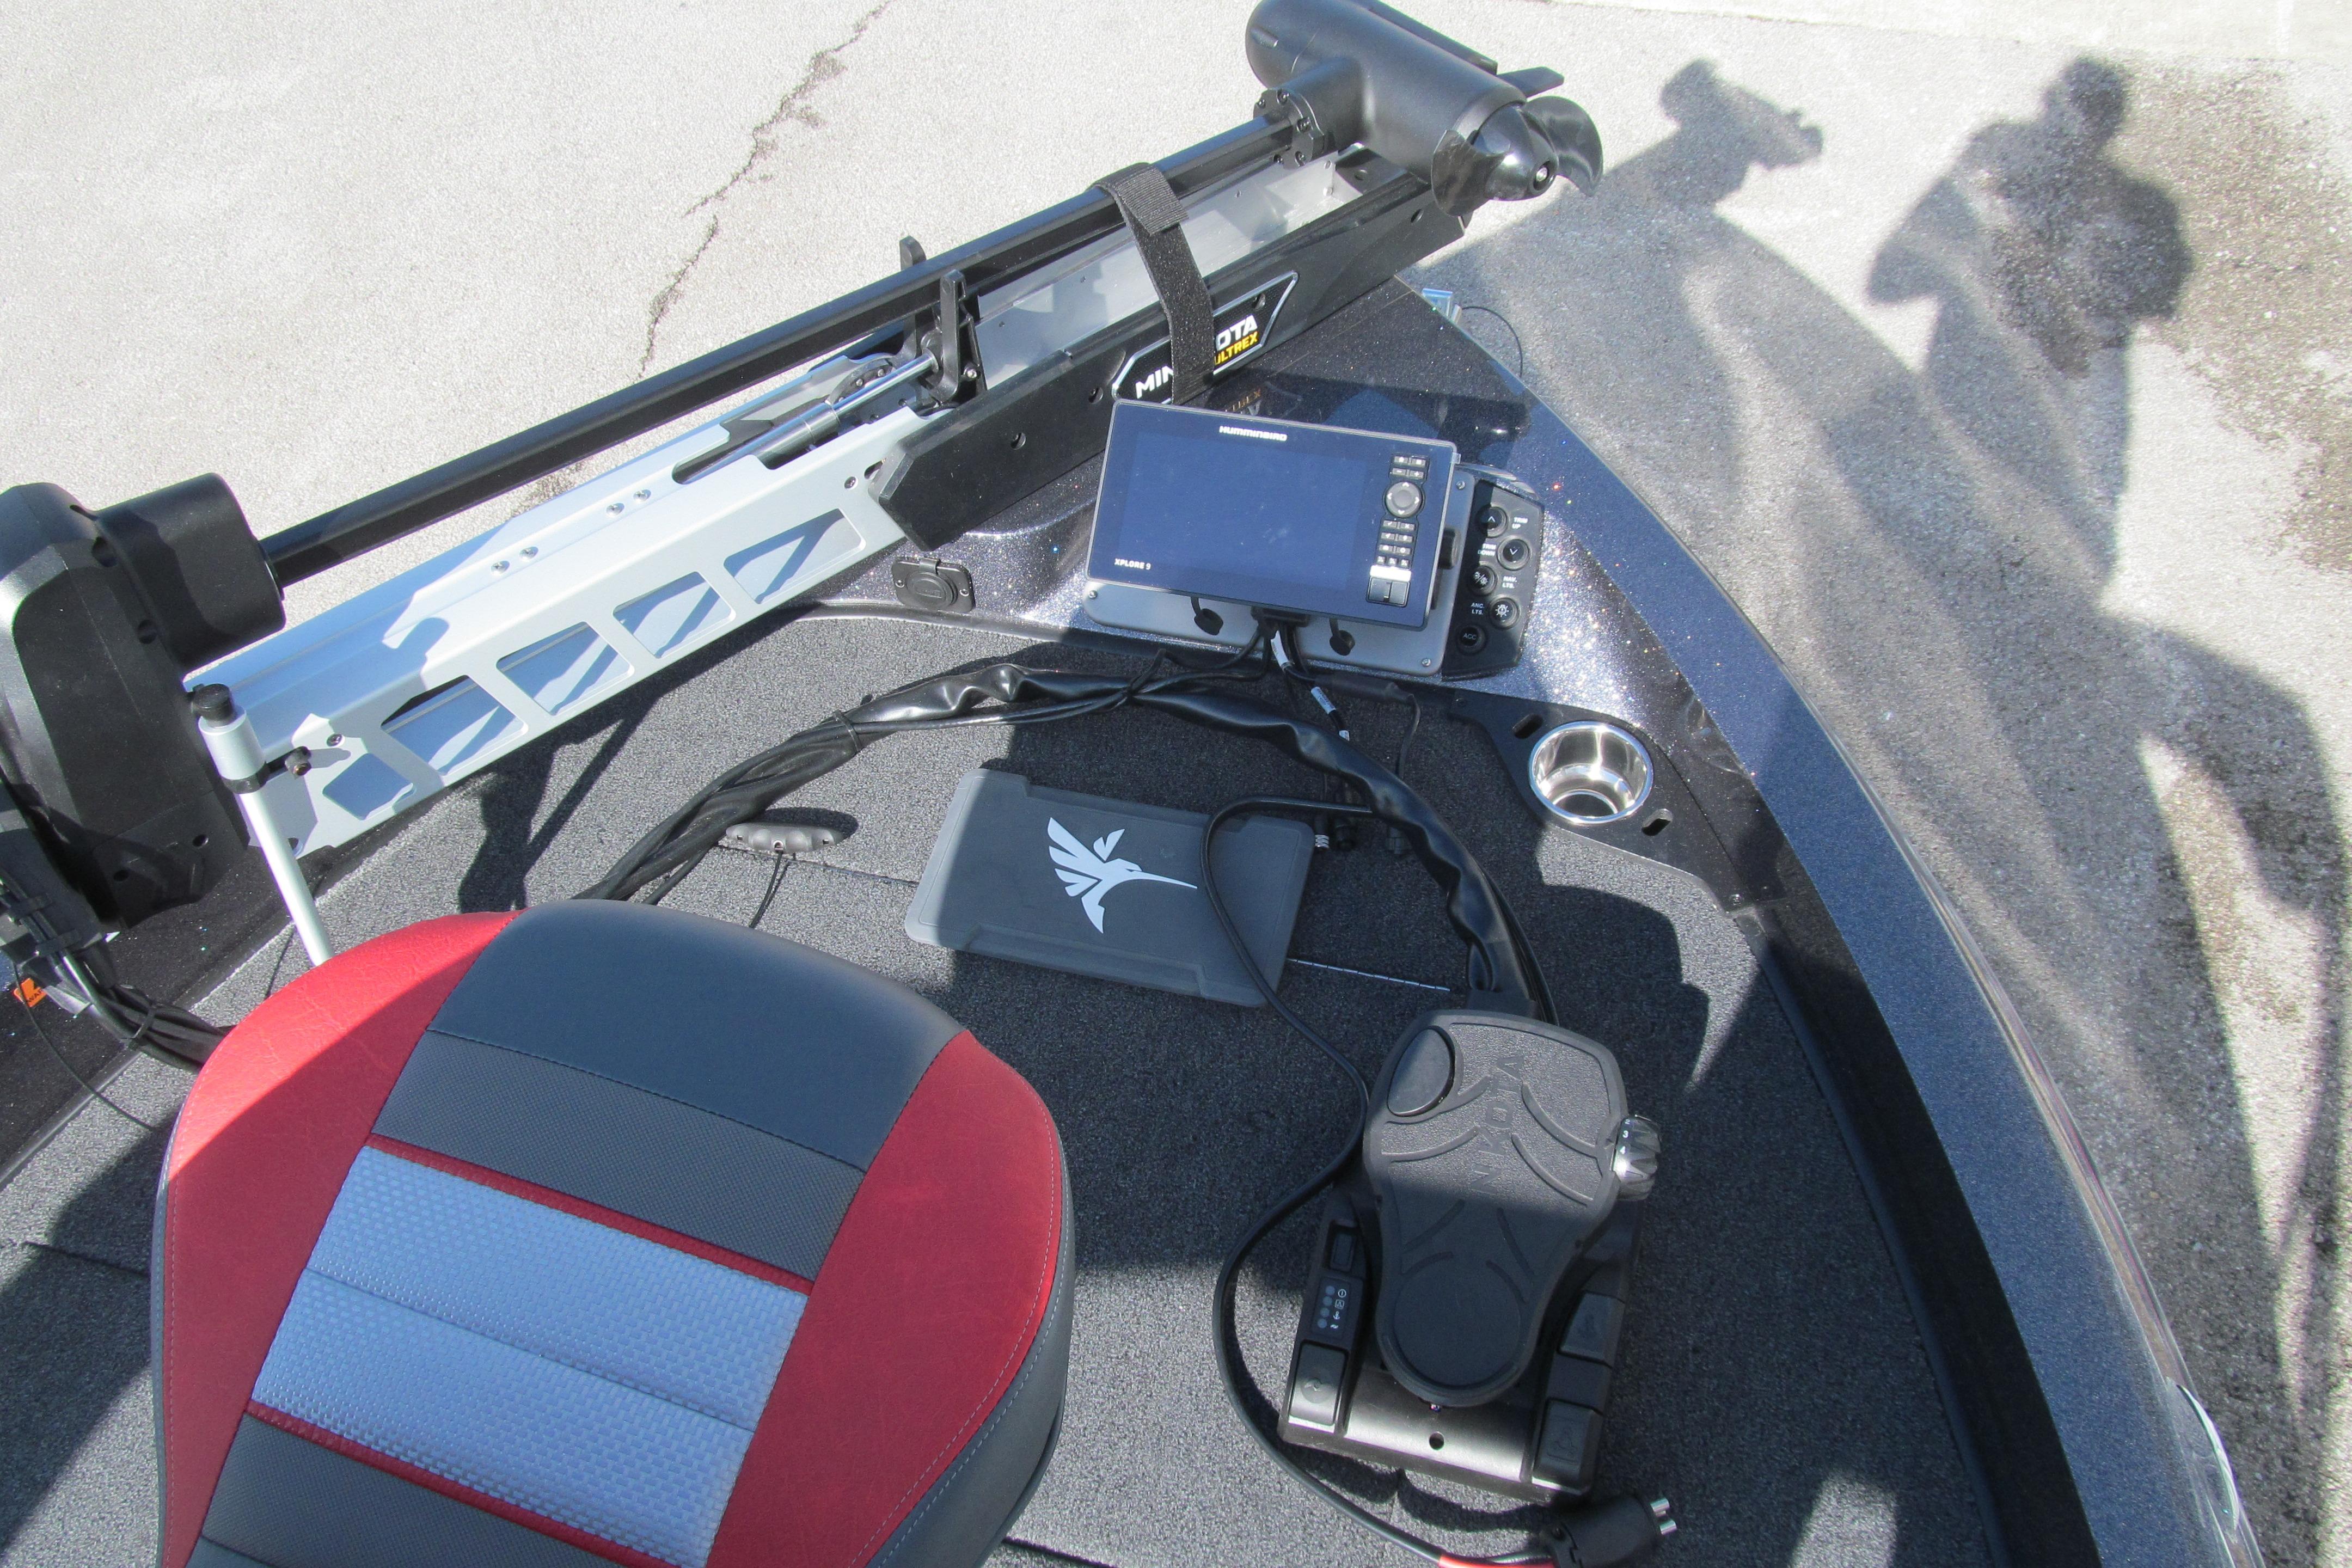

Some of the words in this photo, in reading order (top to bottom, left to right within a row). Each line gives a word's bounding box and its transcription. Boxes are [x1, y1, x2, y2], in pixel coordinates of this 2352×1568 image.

[1214, 330, 1259, 366] ULTREX
[1135, 365, 1174, 399] MIN
[1215, 314, 1258, 351] OTA
[1219, 425, 1288, 441] HUMMINBIRD
[1114, 558, 1145, 569] XPLORE
[1622, 1130, 1628, 1138] 3
[1620, 1146, 1626, 1155] 4
